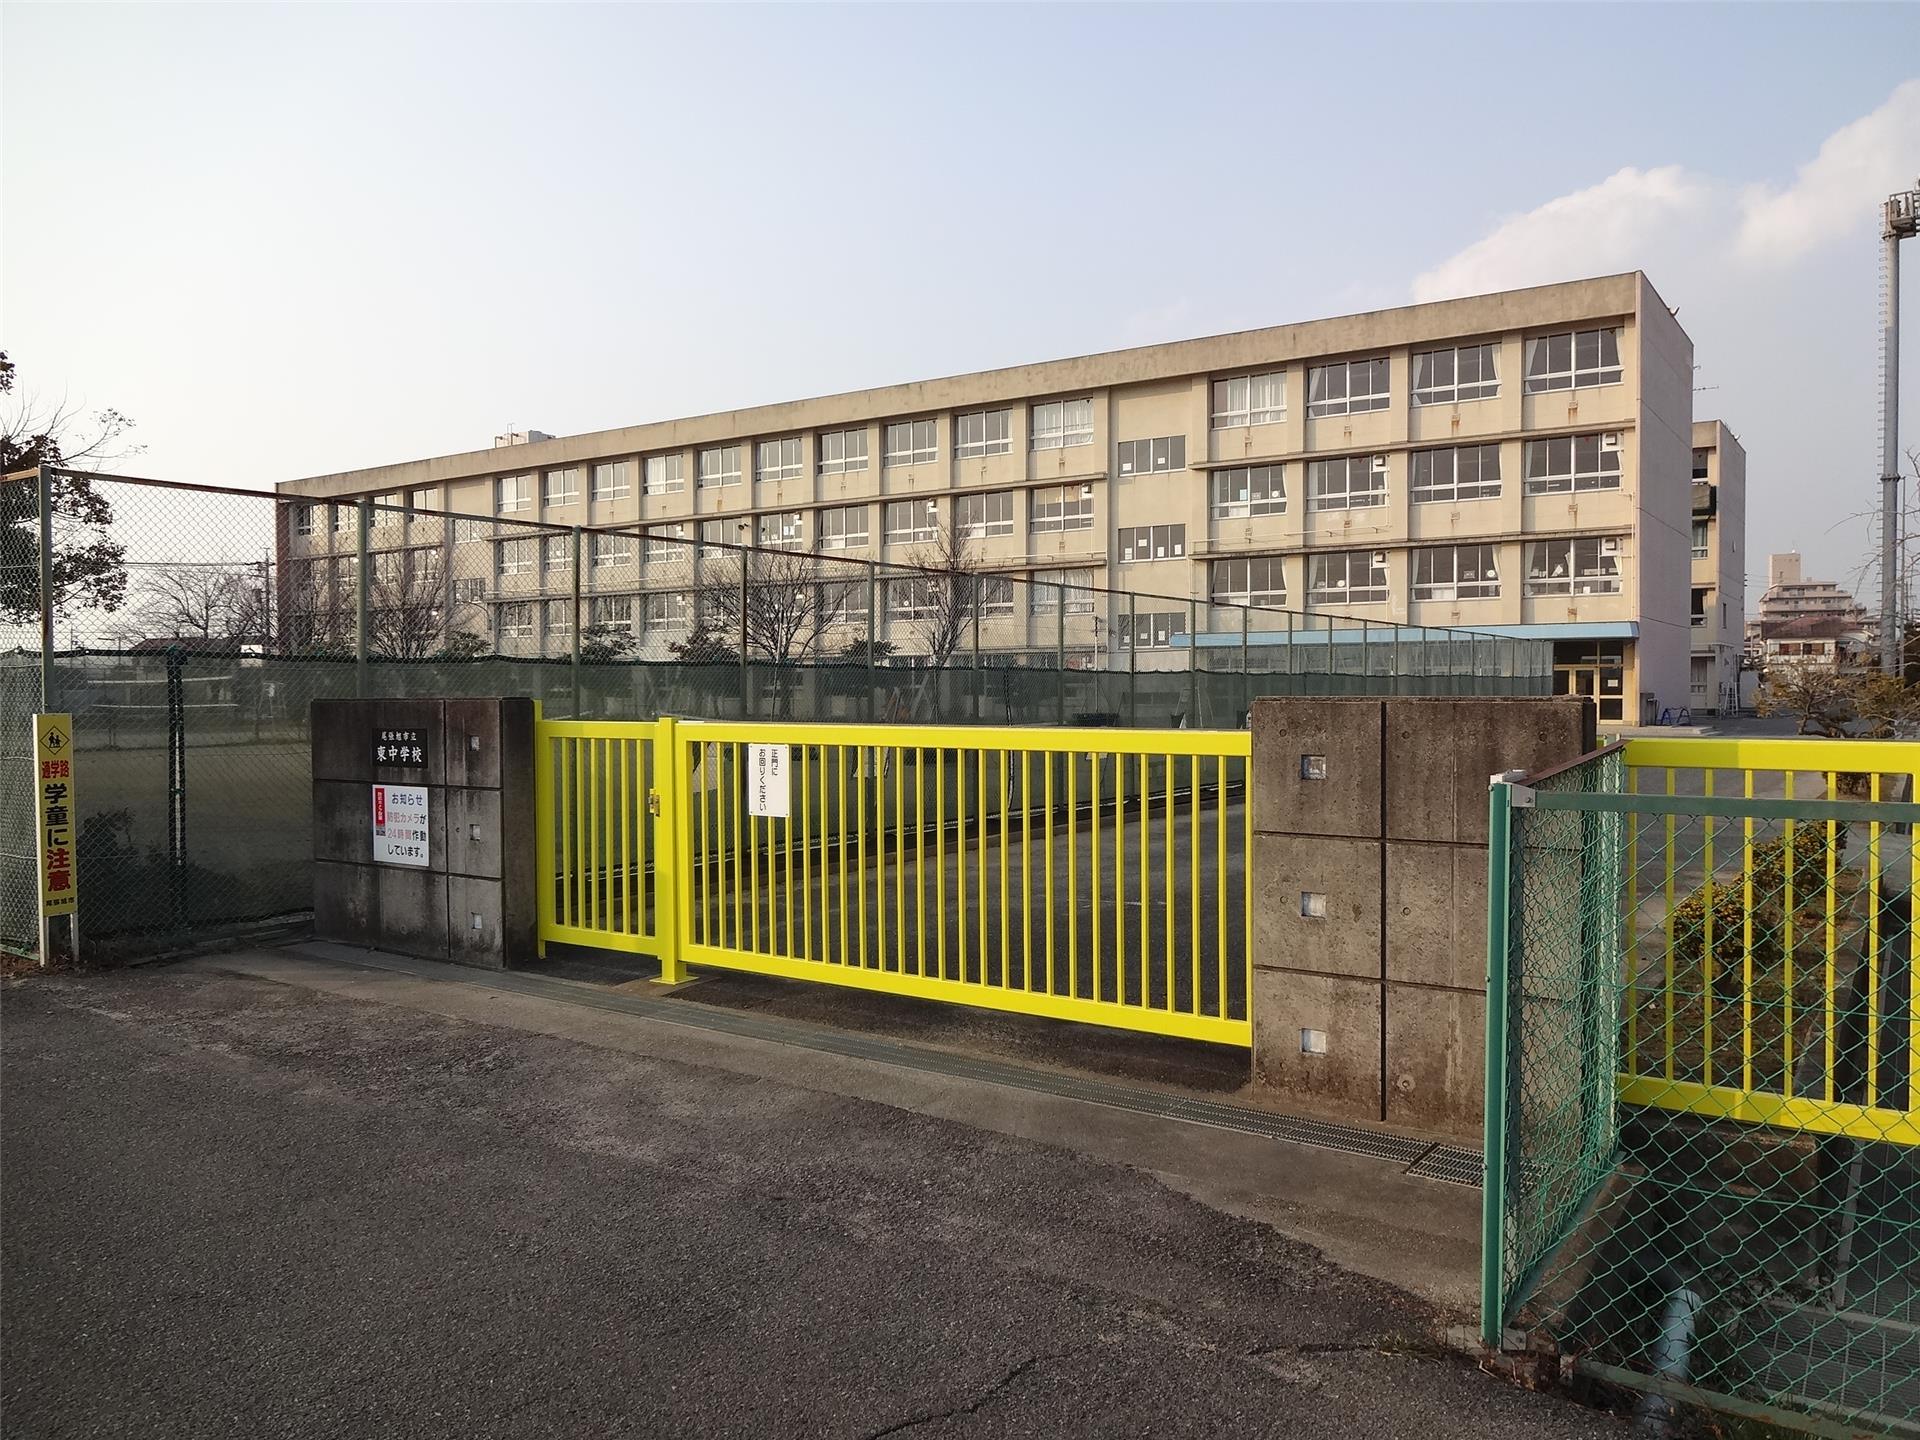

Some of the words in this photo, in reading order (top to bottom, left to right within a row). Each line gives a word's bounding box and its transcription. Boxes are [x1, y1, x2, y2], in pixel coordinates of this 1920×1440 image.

[382, 731, 417, 741] 尾張旭市立
[377, 745, 422, 762] 東中学校
[42, 761, 69, 778] 通学路
[392, 793, 423, 806] お知らせ
[387, 811, 427, 825] 防犯カメラが
[45, 784, 70, 891] 学童に注意
[387, 828, 427, 842] 24時間作動
[387, 844, 424, 858] しています。
